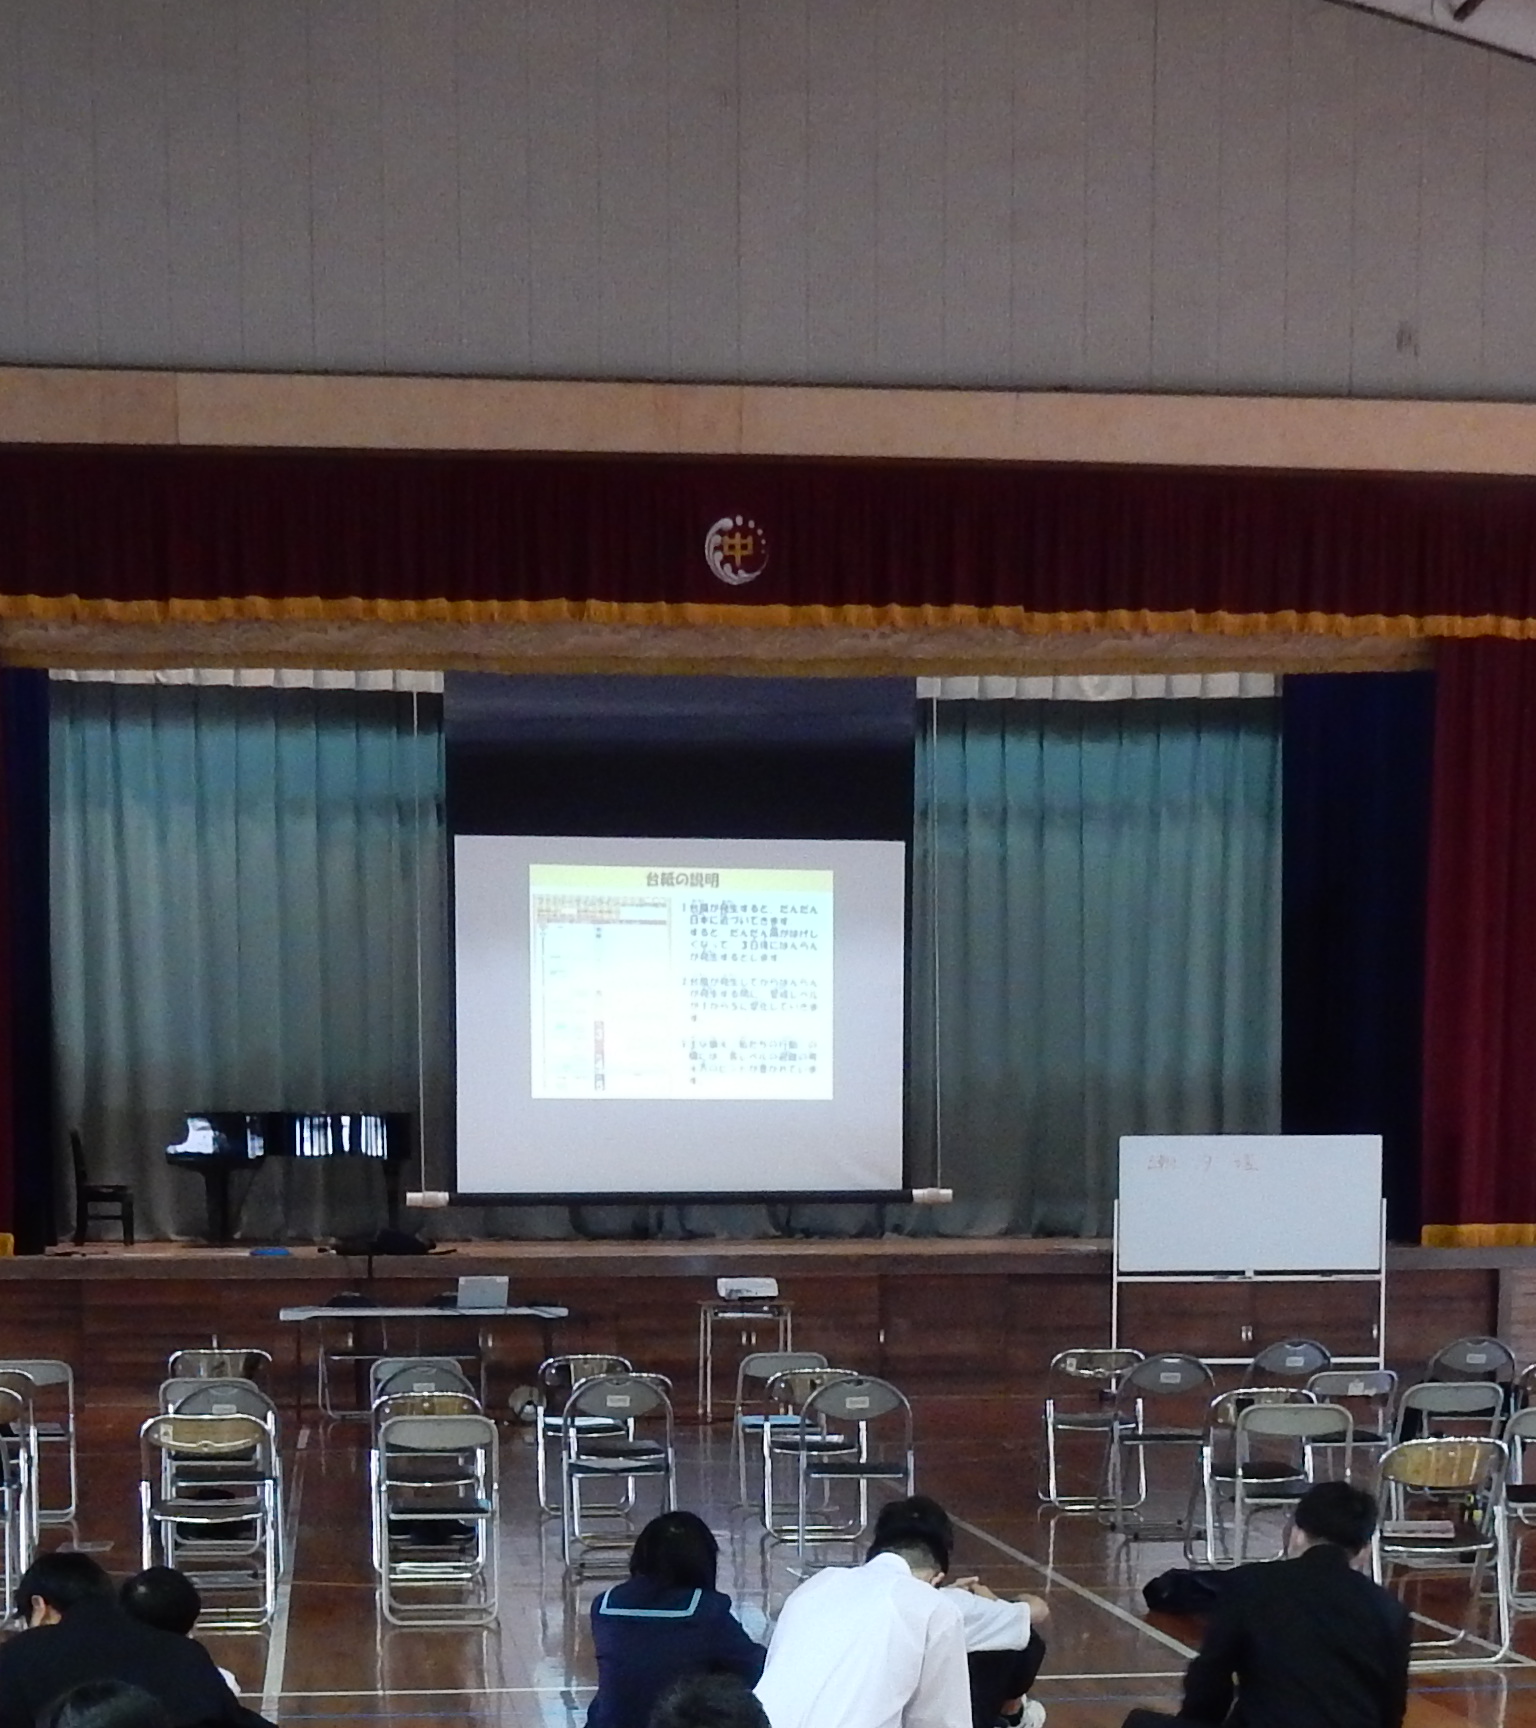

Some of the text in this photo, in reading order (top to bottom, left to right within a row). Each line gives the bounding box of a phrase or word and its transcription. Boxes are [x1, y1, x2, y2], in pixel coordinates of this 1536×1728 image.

[646, 871, 720, 889] 台紙の説明
